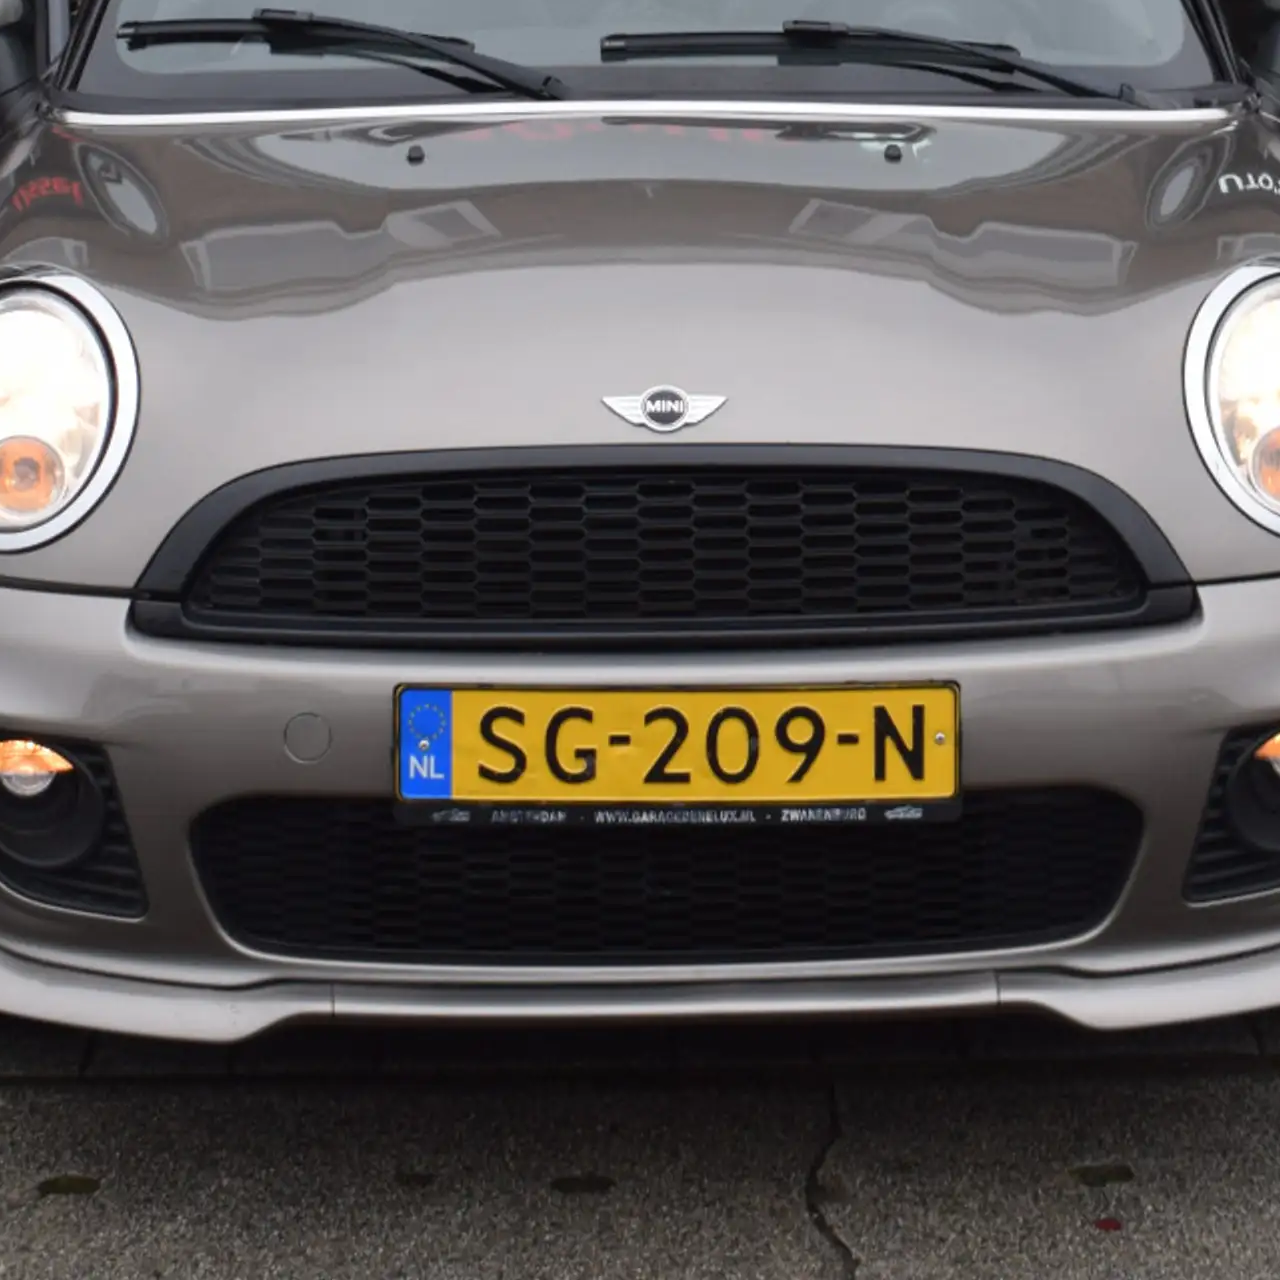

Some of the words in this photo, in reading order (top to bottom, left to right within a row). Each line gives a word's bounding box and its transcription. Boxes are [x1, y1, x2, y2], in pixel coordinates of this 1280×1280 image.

[646, 399, 684, 413] MINI
[408, 755, 444, 779] NL
[477, 704, 926, 785] SG-209-N
